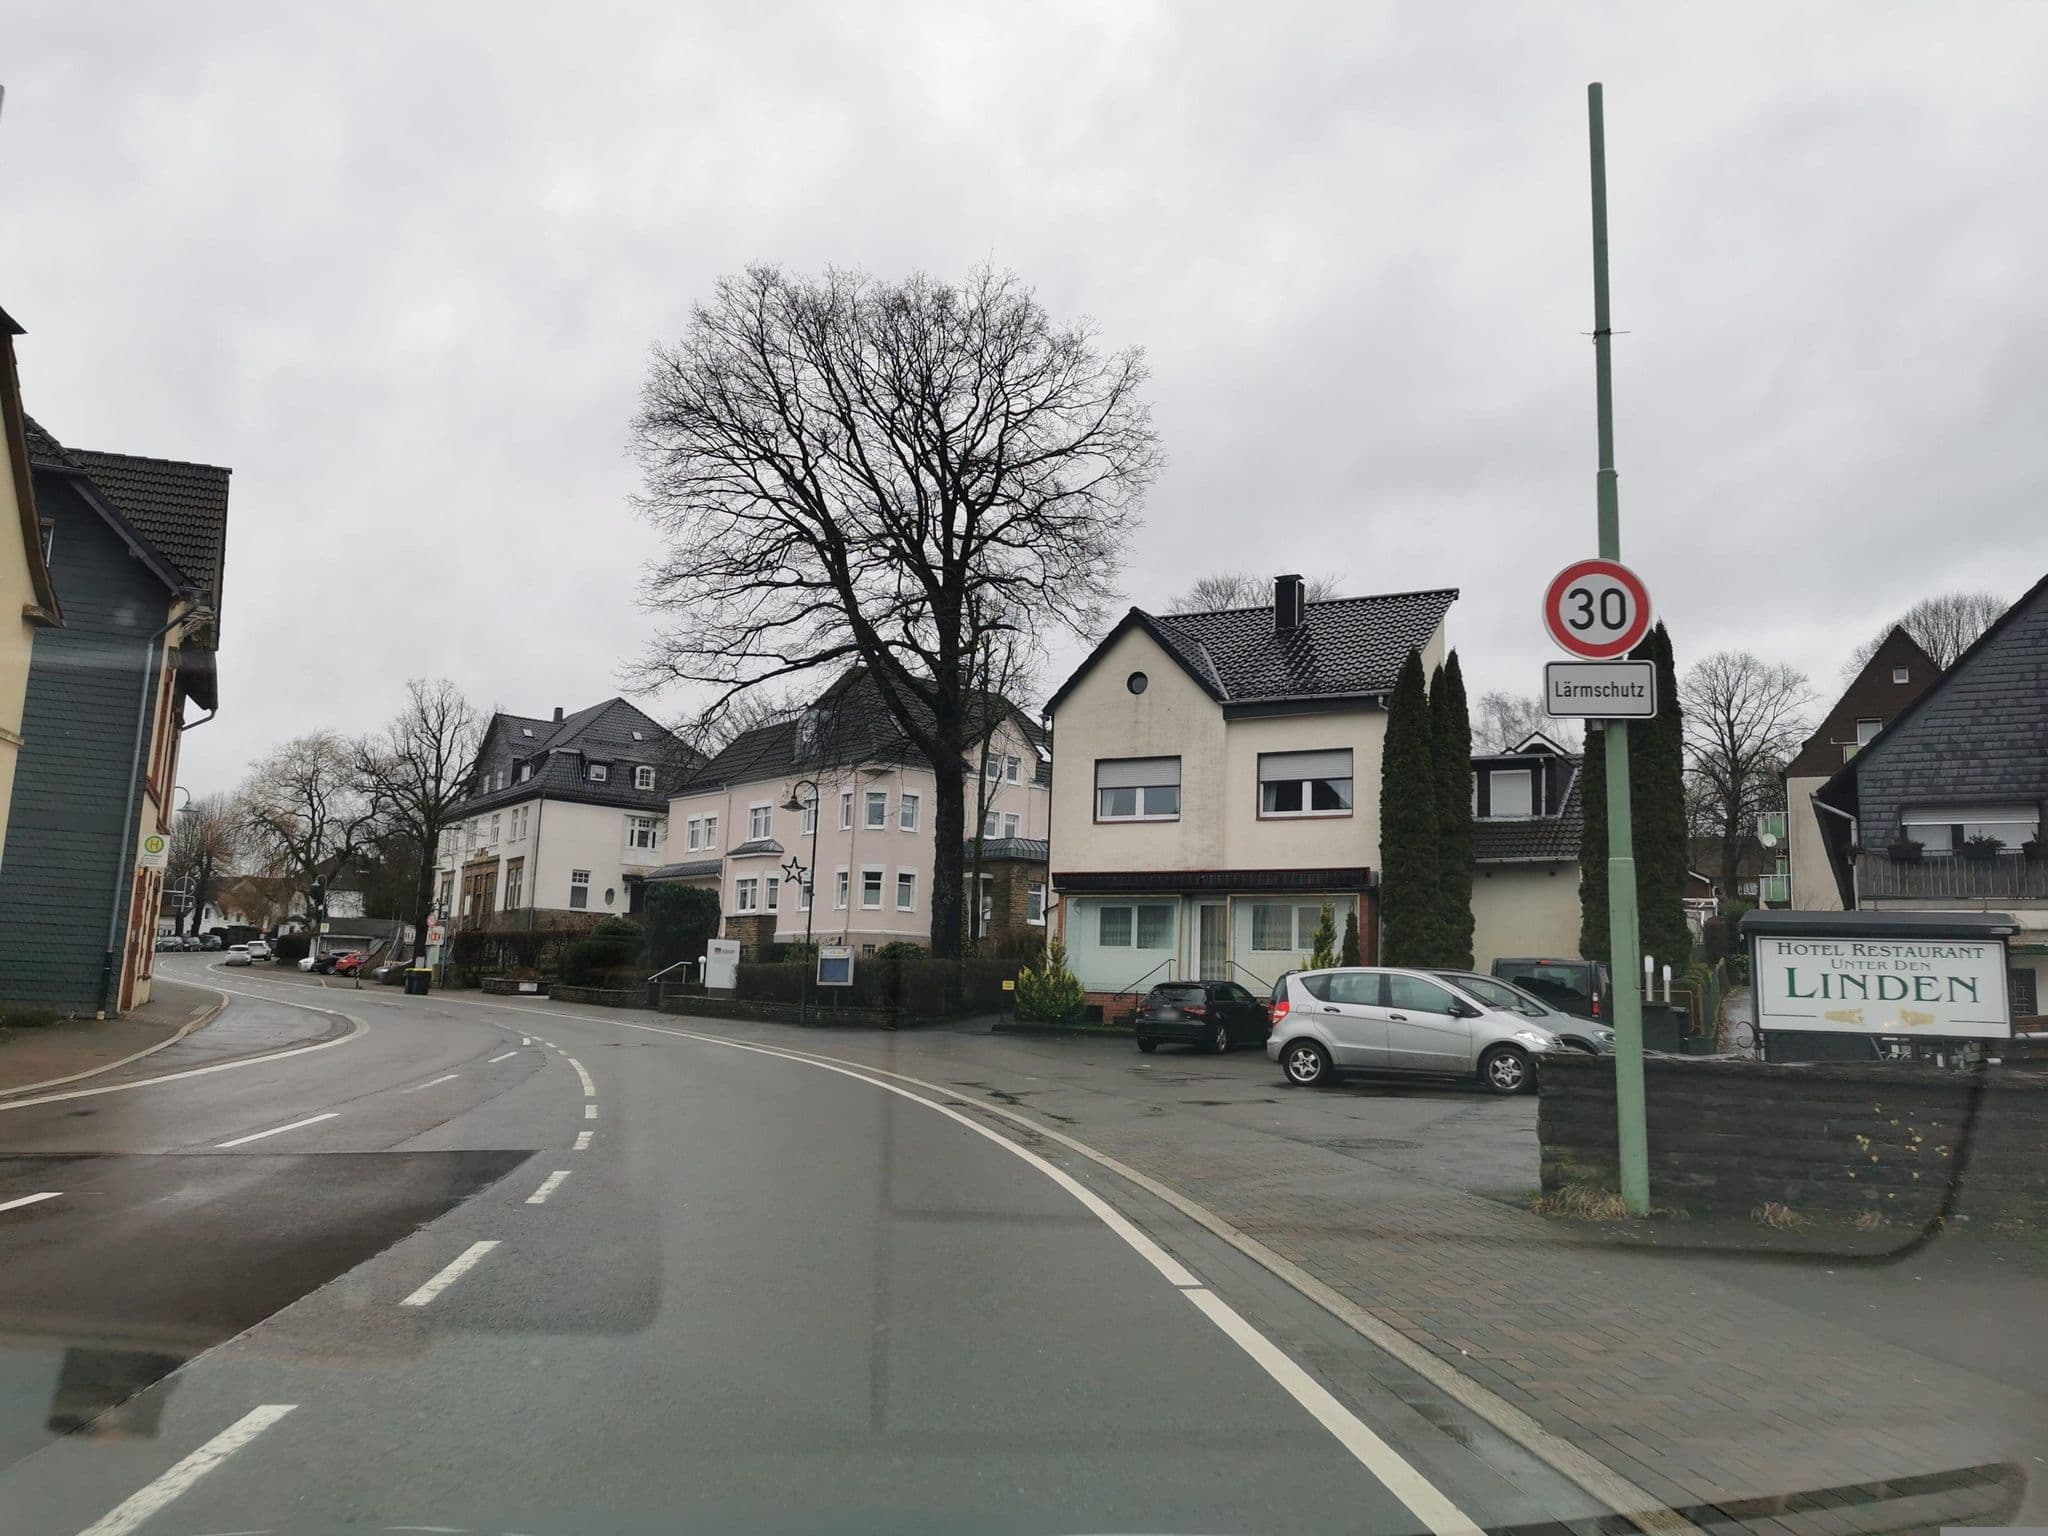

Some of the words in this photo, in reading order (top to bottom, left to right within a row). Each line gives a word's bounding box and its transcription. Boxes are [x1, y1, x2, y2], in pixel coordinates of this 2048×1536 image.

[1568, 587, 1626, 630] 30
[1555, 681, 1645, 698] Lärmschutz
[150, 840, 160, 850] H
[1777, 942, 1844, 956] HOTEL
[1853, 943, 1985, 959] RESTAURANT
[1831, 959, 1887, 970] UNTER
[1895, 960, 1931, 971] DEN
[1784, 967, 1980, 1003] LINDEN
